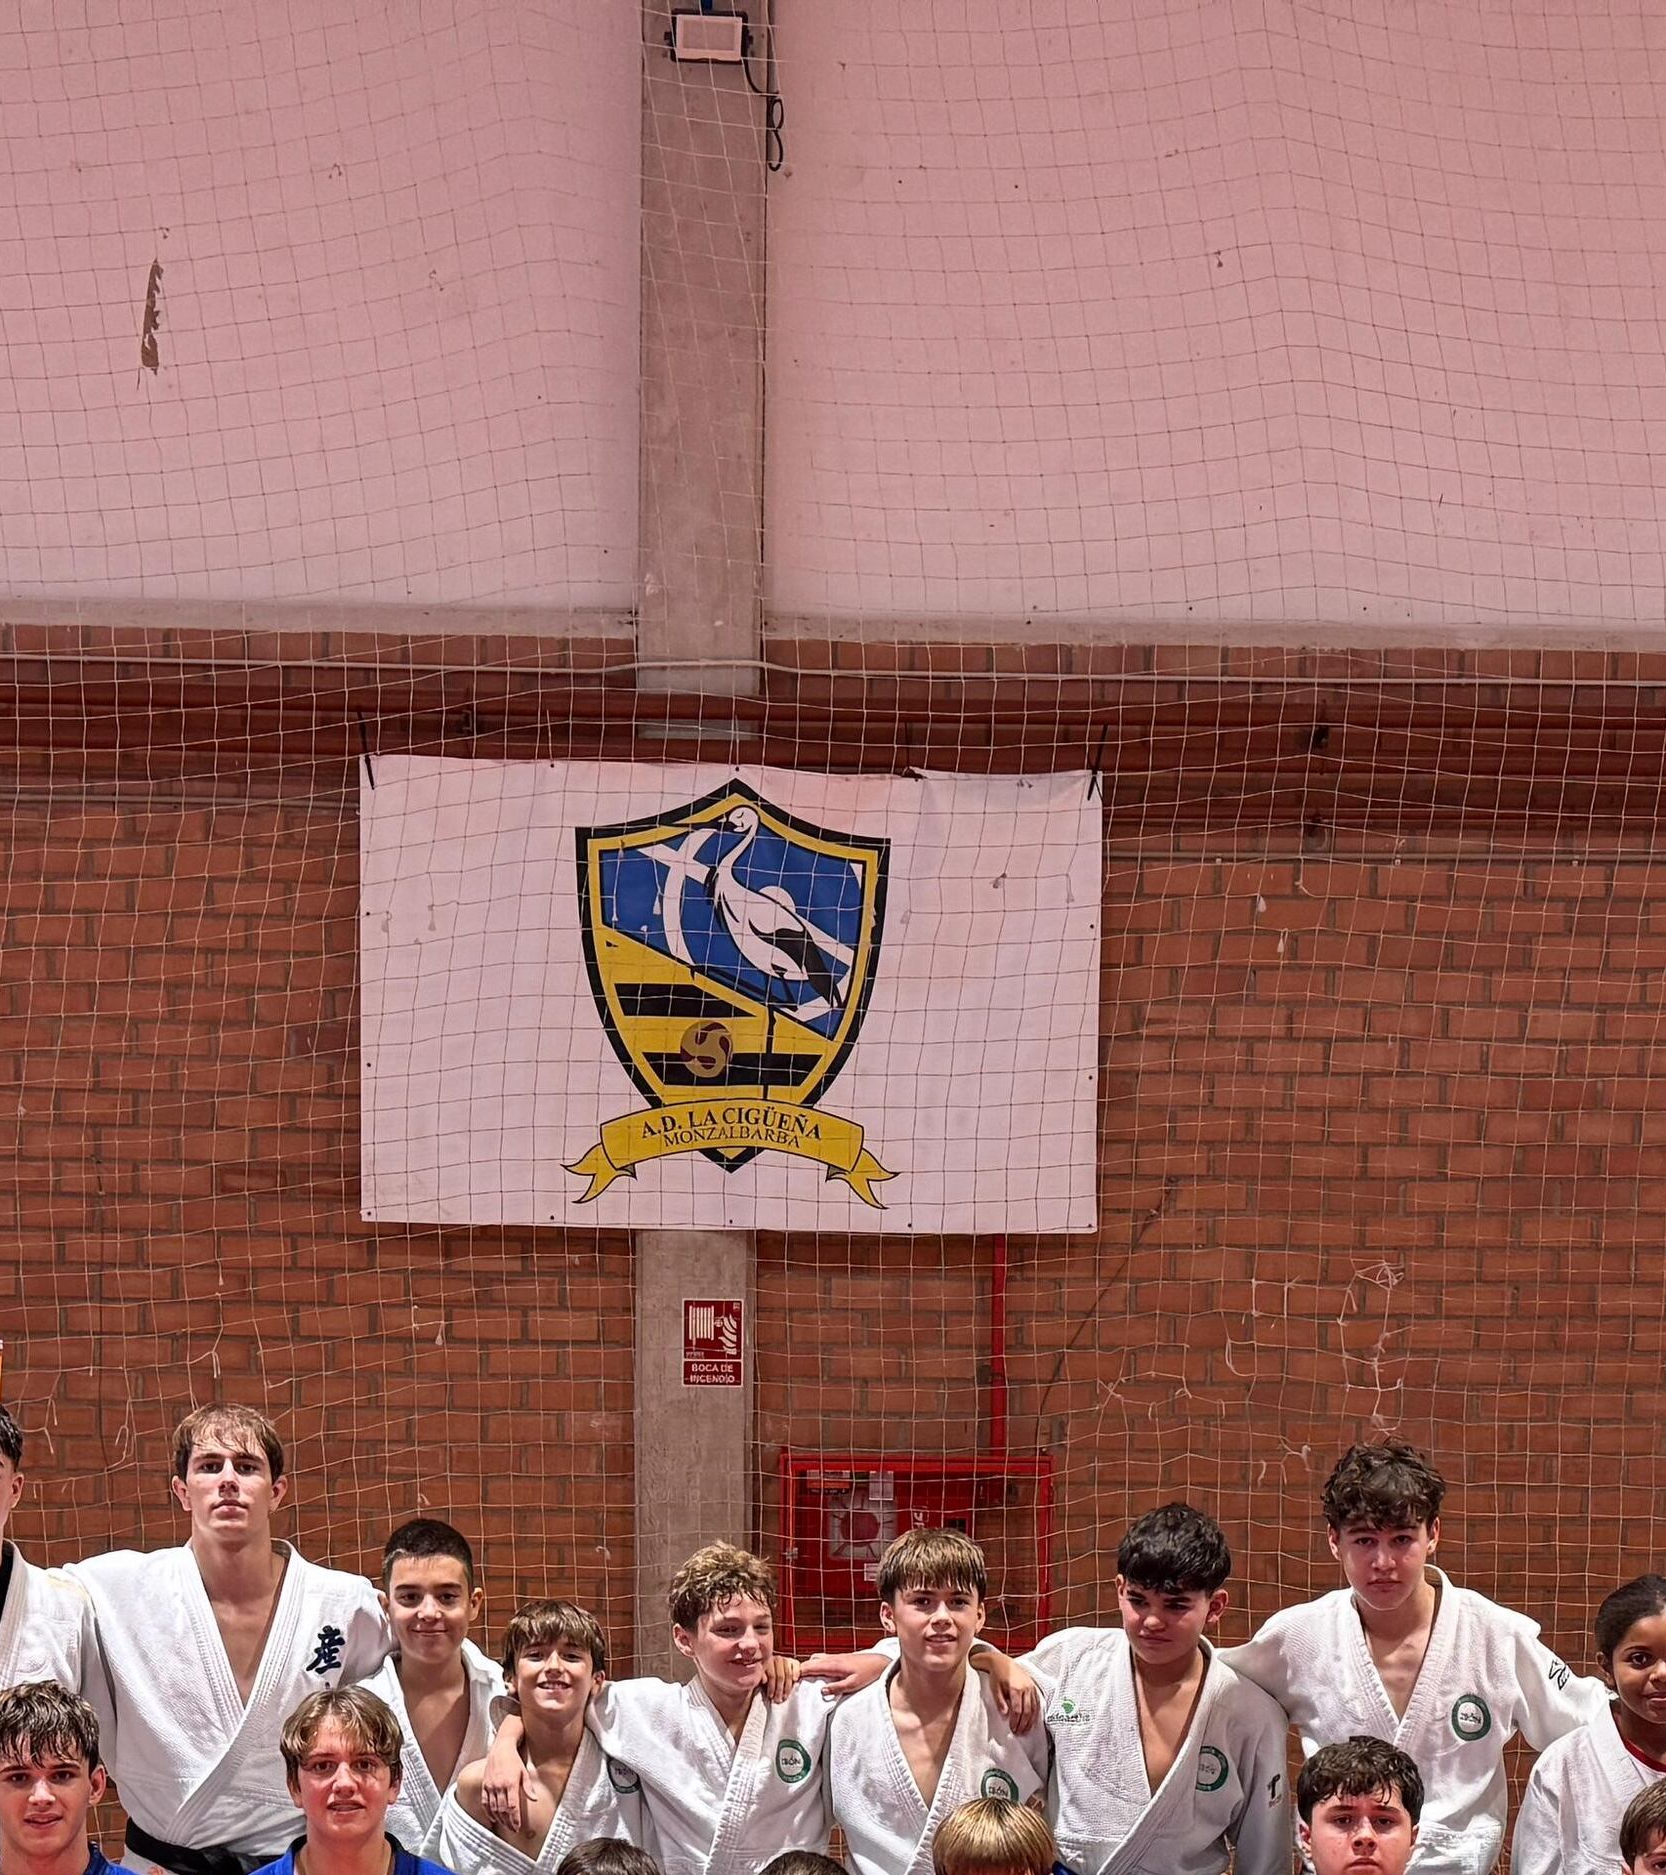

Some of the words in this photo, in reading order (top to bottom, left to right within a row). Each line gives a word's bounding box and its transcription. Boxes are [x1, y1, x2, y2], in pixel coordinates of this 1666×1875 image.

[642, 1115, 682, 1138] A.D.
[688, 1109, 717, 1128] LA
[722, 1106, 822, 1140] CIGÜEÑA
[664, 1125, 801, 1148] MONZALBARBA
[691, 1363, 719, 1373] BOCA
[720, 1363, 734, 1373] DE
[689, 1374, 735, 1384] INCENDIO
